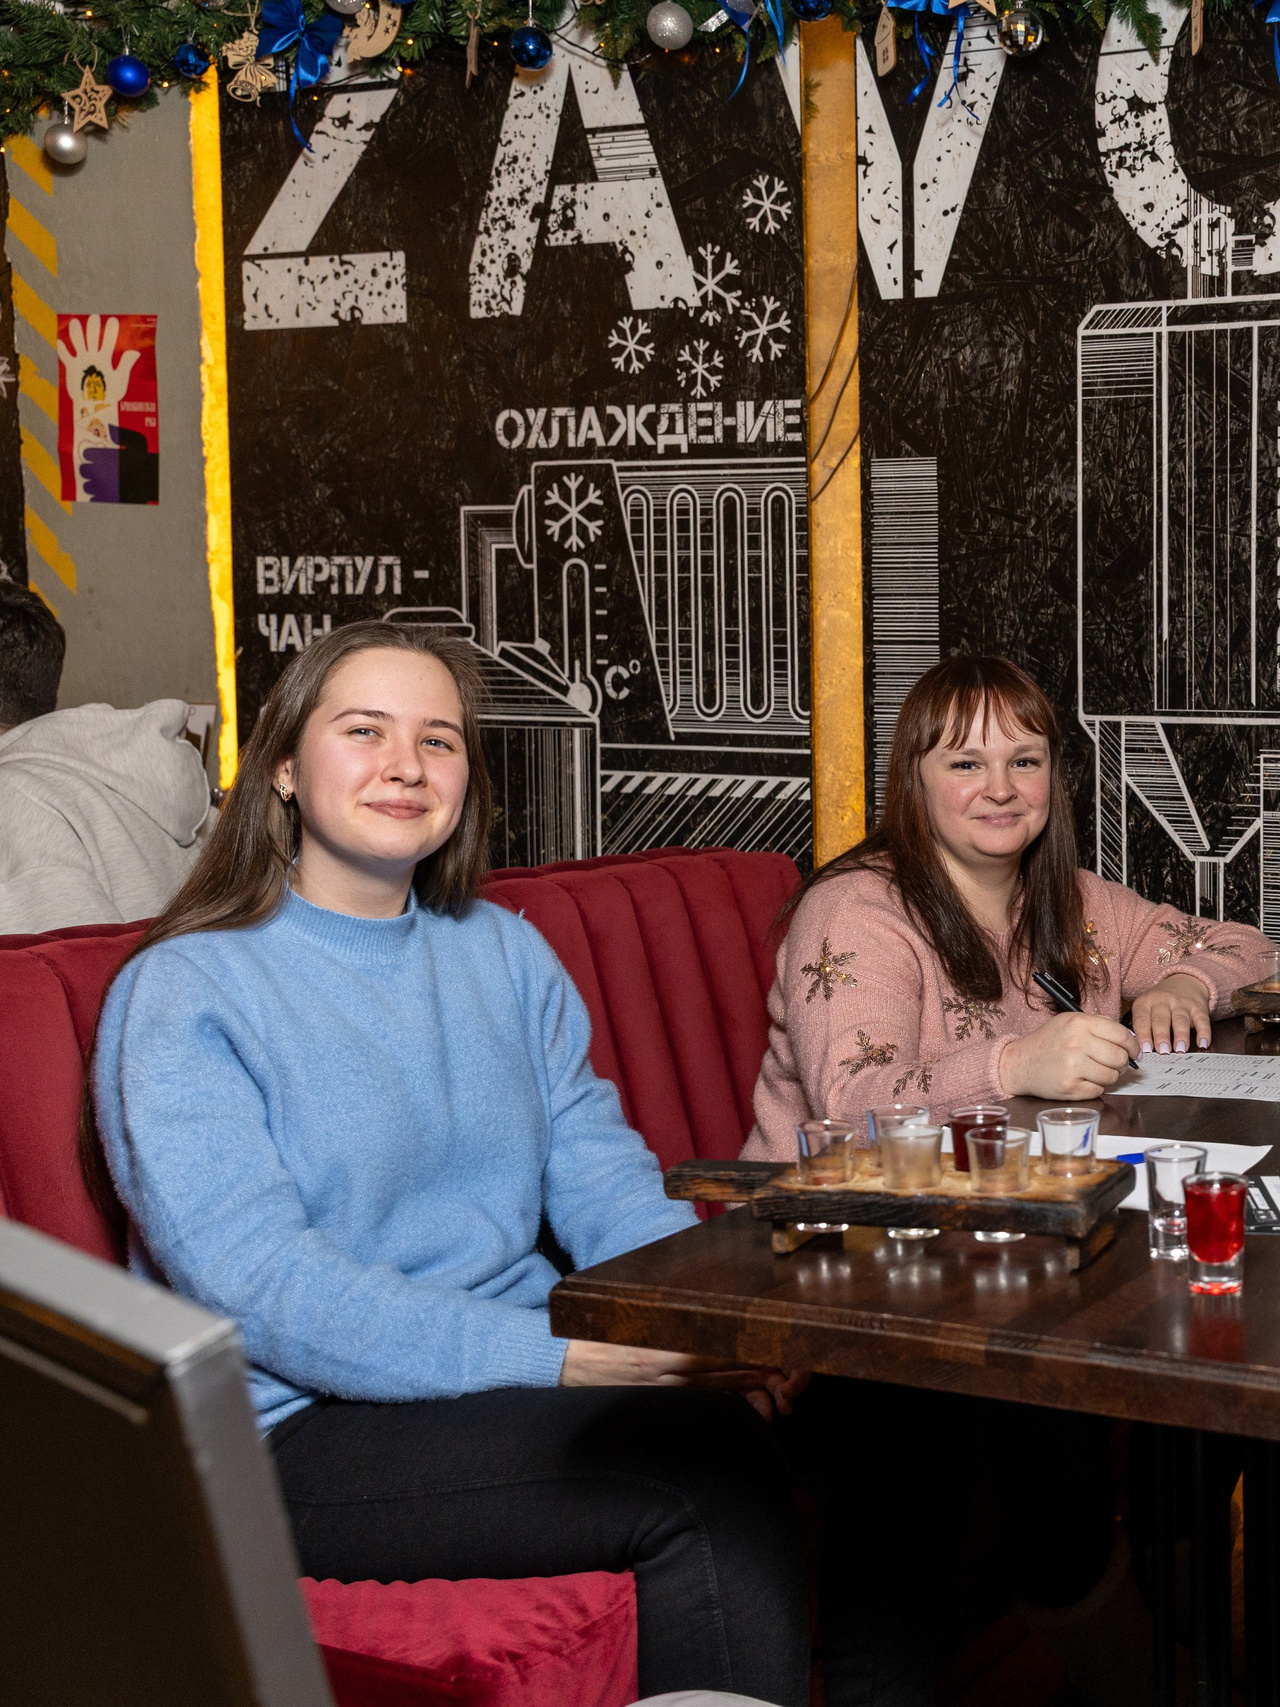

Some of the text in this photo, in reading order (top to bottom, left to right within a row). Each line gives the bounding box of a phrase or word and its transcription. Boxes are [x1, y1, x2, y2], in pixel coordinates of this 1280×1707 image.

[495, 399, 803, 455] ОХЛАЖДЕНИЕ
[256, 556, 401, 595] ВИРПУЛ
[257, 613, 332, 653] ЧАН
